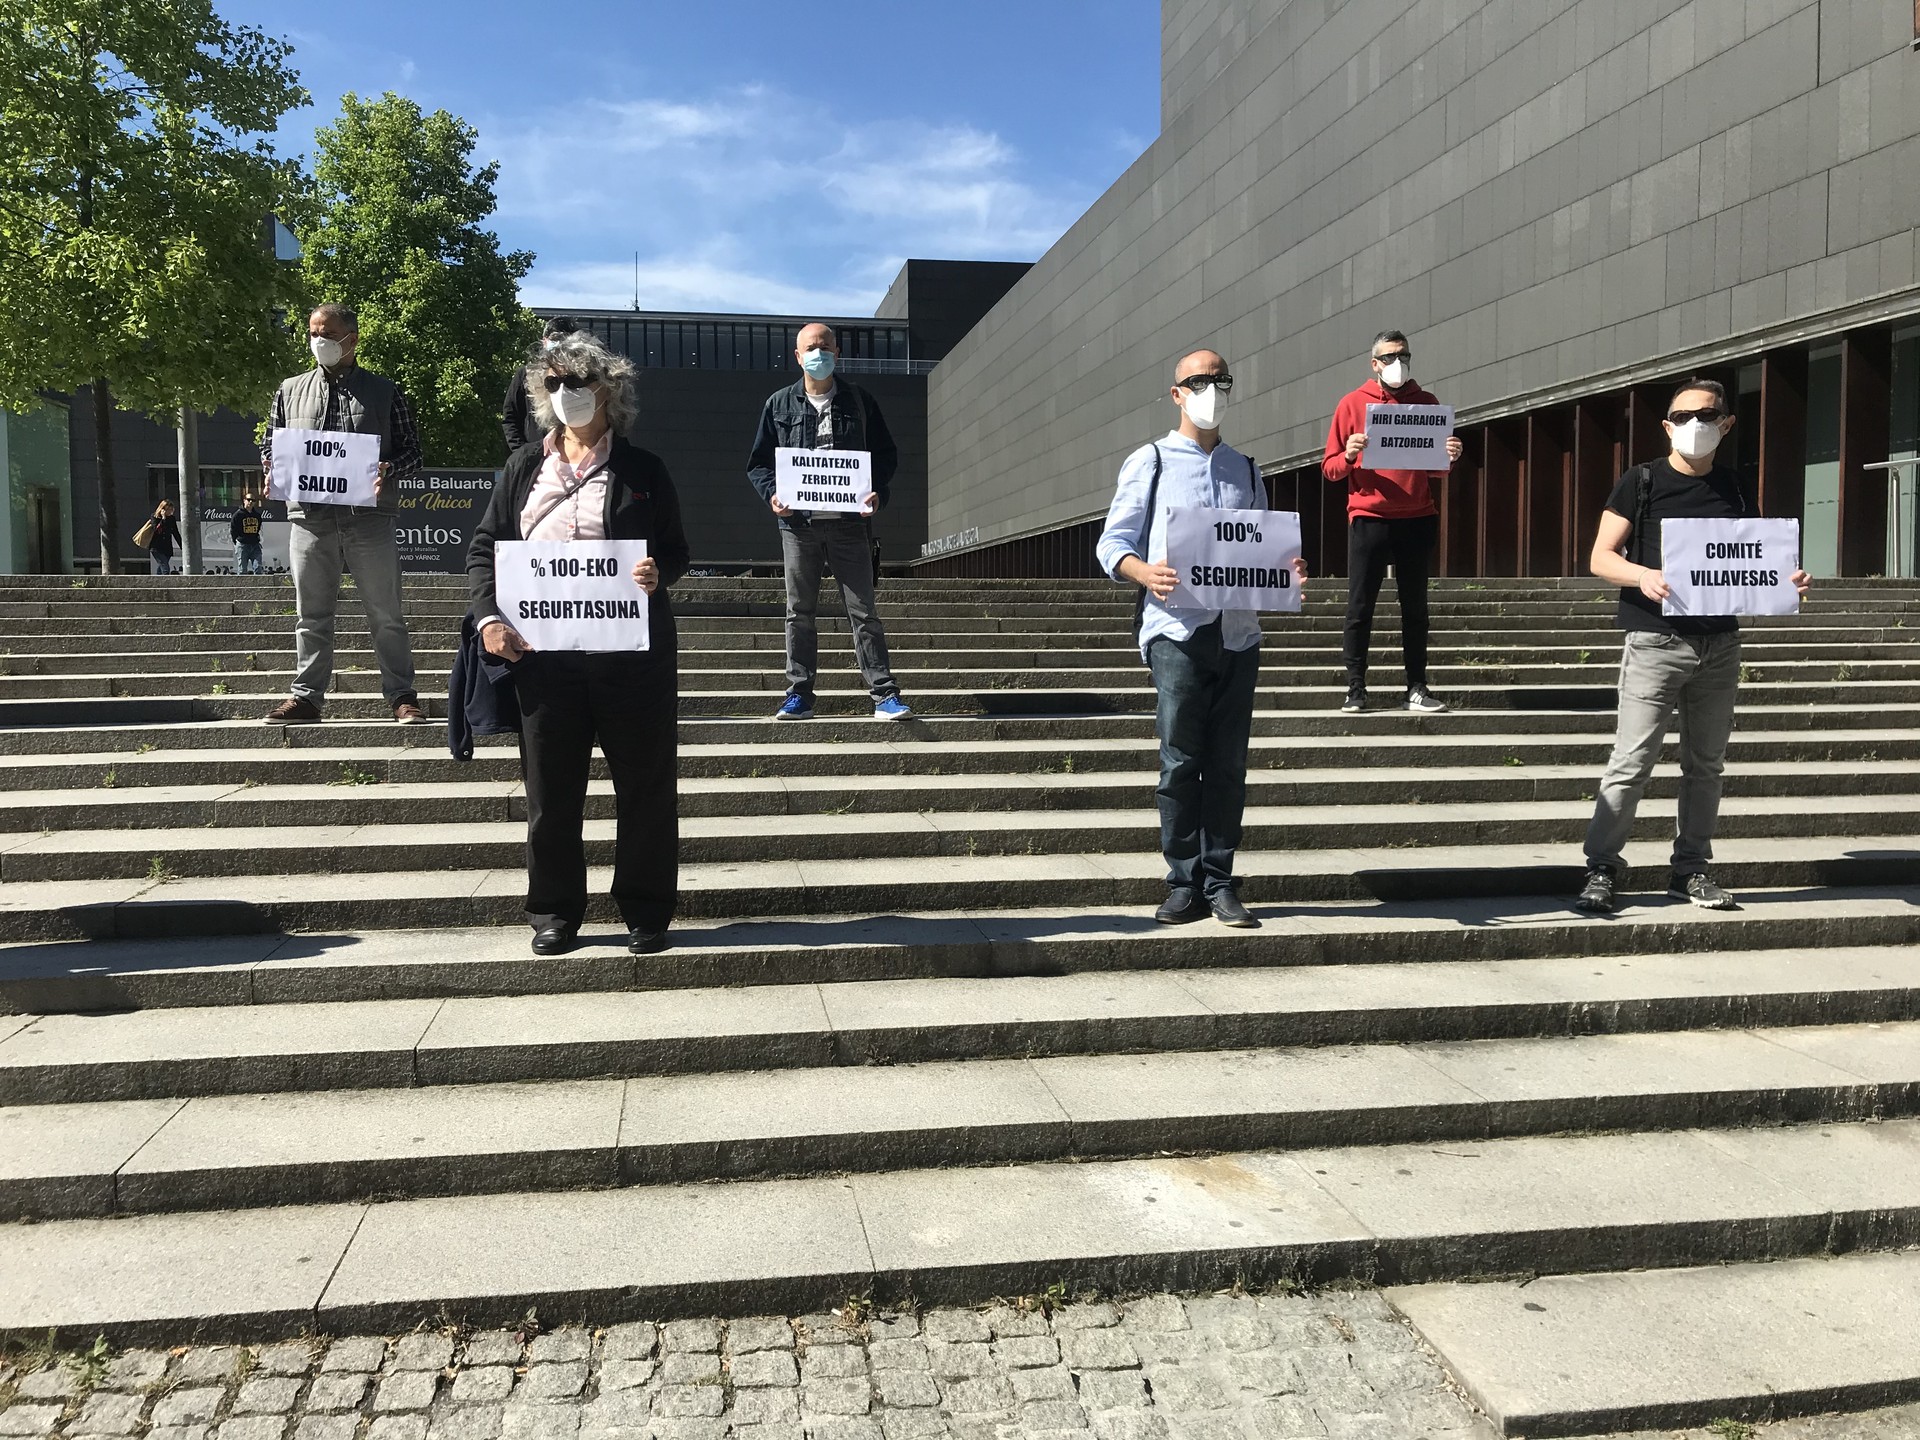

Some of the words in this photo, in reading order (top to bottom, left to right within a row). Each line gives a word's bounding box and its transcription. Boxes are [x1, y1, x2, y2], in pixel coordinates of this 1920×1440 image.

[1372, 414, 1392, 425] HIRI
[1394, 414, 1447, 426] GARRAIOEN
[304, 440, 347, 458] 100%
[1381, 437, 1434, 448] BATZORDEA
[792, 456, 860, 469] KALITATEZKO
[298, 475, 348, 494] SALUD
[399, 477, 425, 489] mía
[430, 477, 492, 489] Baluarte
[802, 474, 850, 486] ZERBITZU
[420, 490, 473, 511] Únicos
[797, 491, 857, 503] PUBLIKOAK
[204, 508, 232, 519] Nueva
[396, 524, 462, 545] entos
[1214, 522, 1262, 543] 100%
[1705, 540, 1763, 559] COMITÉ
[530, 558, 546, 578] %
[549, 558, 618, 578] 100-EKO
[689, 568, 708, 577] Gogh
[1191, 565, 1291, 589] SEGURIDAD
[1690, 569, 1779, 587] VILLAVESAS
[519, 600, 641, 620] SEGURTASUNA
